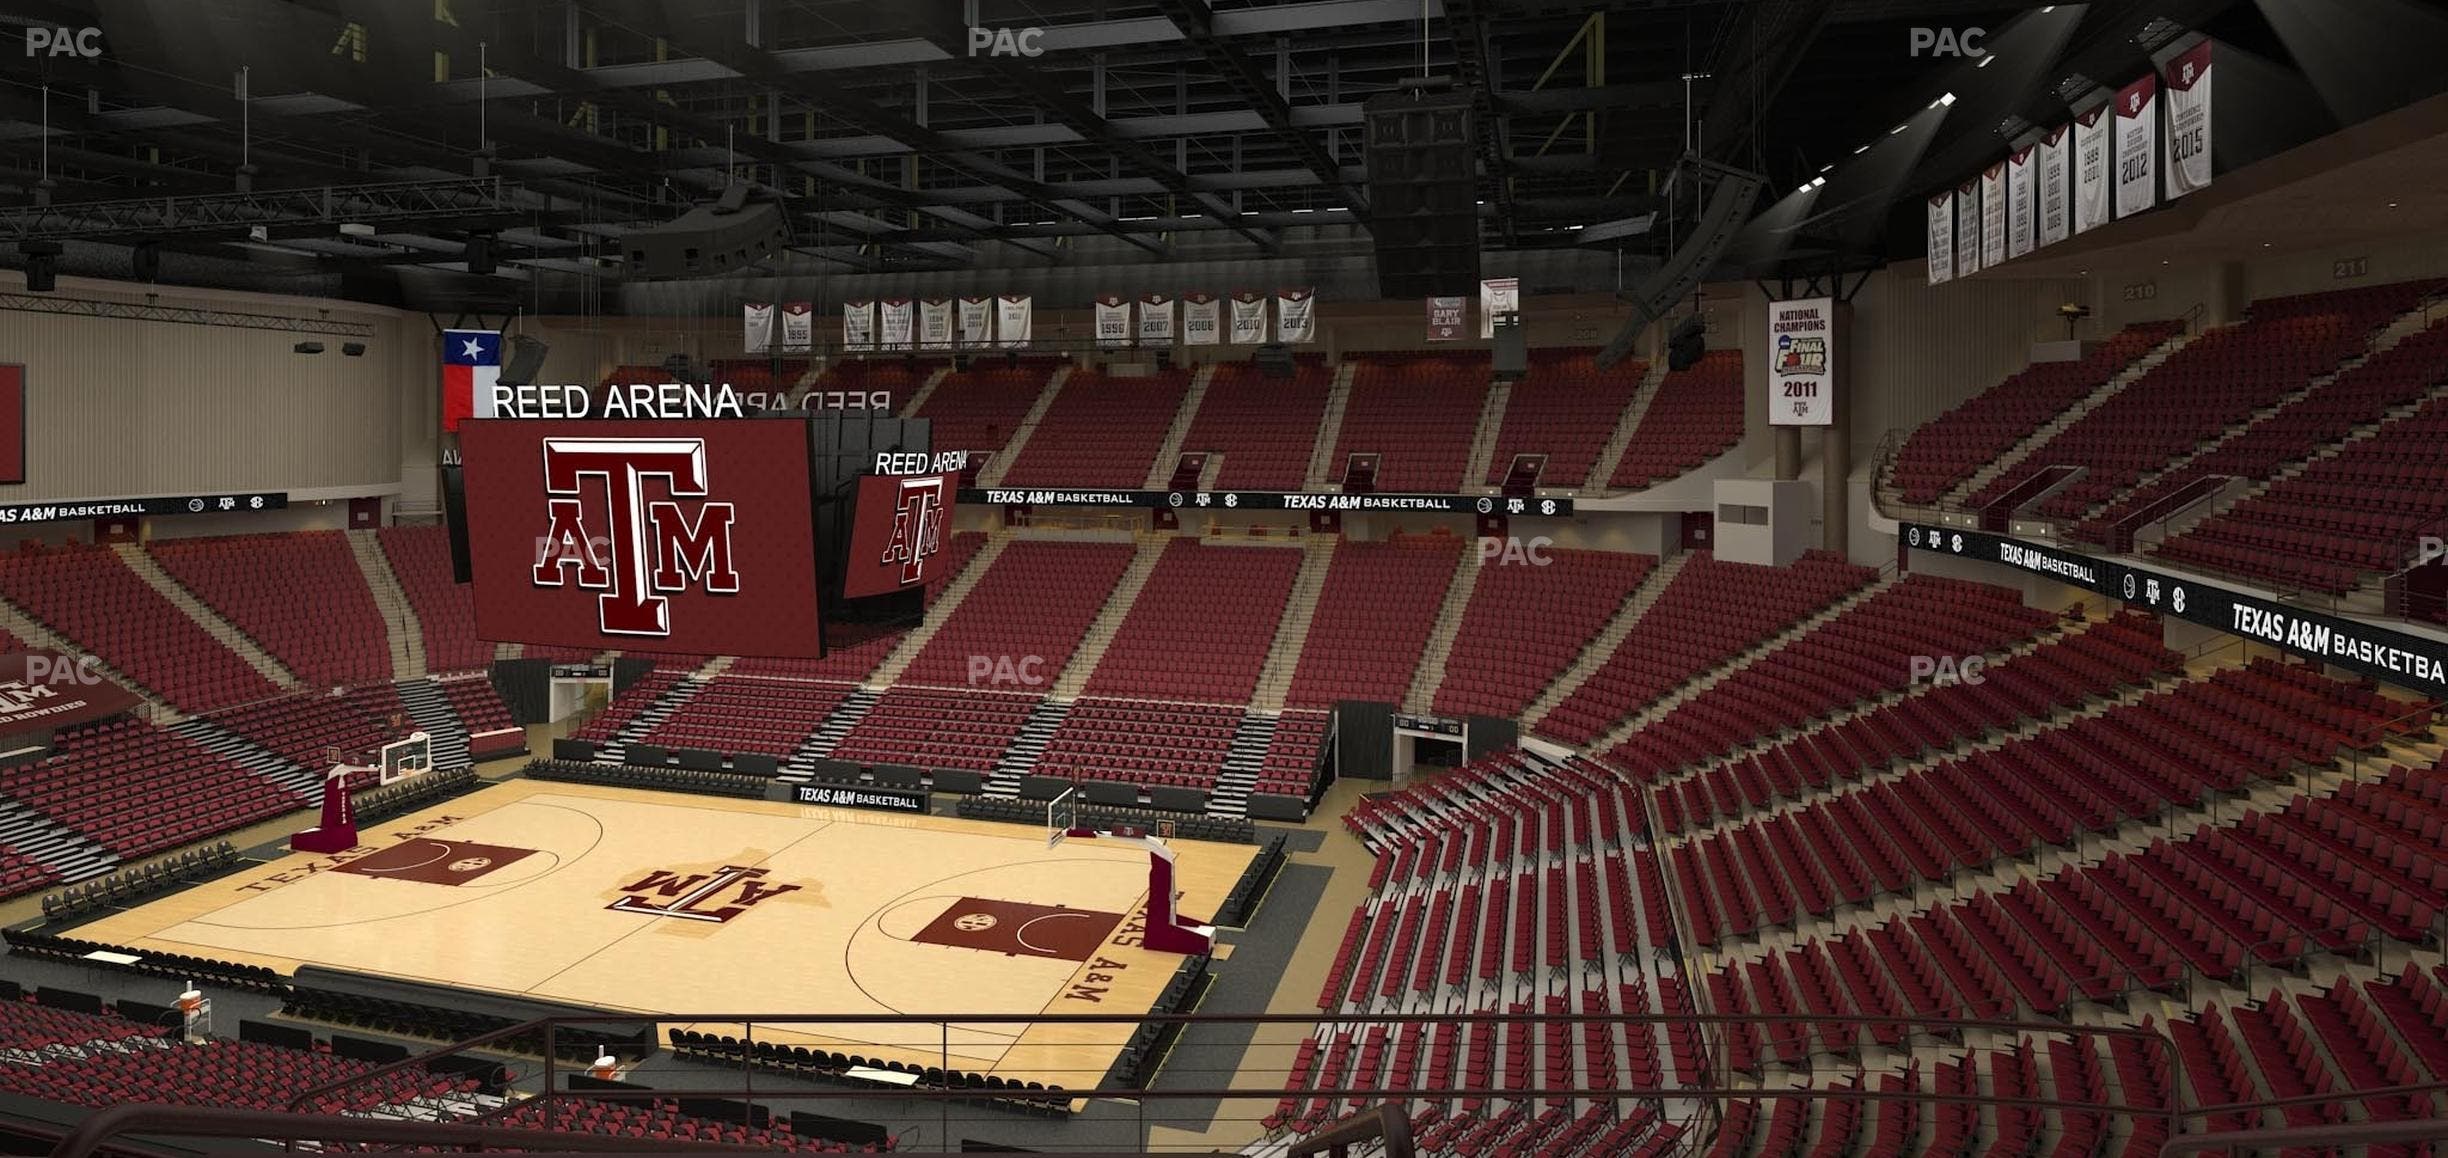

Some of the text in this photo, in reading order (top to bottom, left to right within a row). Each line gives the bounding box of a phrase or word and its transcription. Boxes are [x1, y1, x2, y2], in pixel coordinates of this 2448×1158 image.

[2173, 127, 2203, 163] 2015
[2122, 152, 2147, 185] 2012
[2336, 258, 2368, 277] 211
[2123, 283, 2156, 301] 210
[1433, 309, 1460, 318] GARY
[1780, 308, 1819, 321] NATIONAL
[1144, 321, 1168, 332] 2007
[1237, 319, 1259, 331] 2010
[1284, 318, 1307, 329] 2013
[1774, 320, 1826, 333] CHAMPIONS
[1790, 339, 1824, 353] FINAL
[1784, 381, 1817, 397] 2011
[491, 385, 590, 418] REED
[603, 383, 743, 418] ARENA
[875, 450, 967, 475] REED ARENA
[987, 490, 1133, 504] TEXAS A&M BASKETBALL
[1283, 495, 1451, 509] TEXAS A&M BASKETBALL
[20, 506, 57, 521] A&M
[59, 503, 146, 517] BASKETBALL
[2000, 542, 2096, 583] TEXAS A&M BASKETBALL
[2233, 603, 2285, 642] TEXAS
[2287, 618, 2330, 656] A&M
[14, 700, 88, 721] ROWDIES
[800, 786, 918, 808] TEXAS A&M BASKETBALL
[1064, 957, 1128, 1003] A&M
